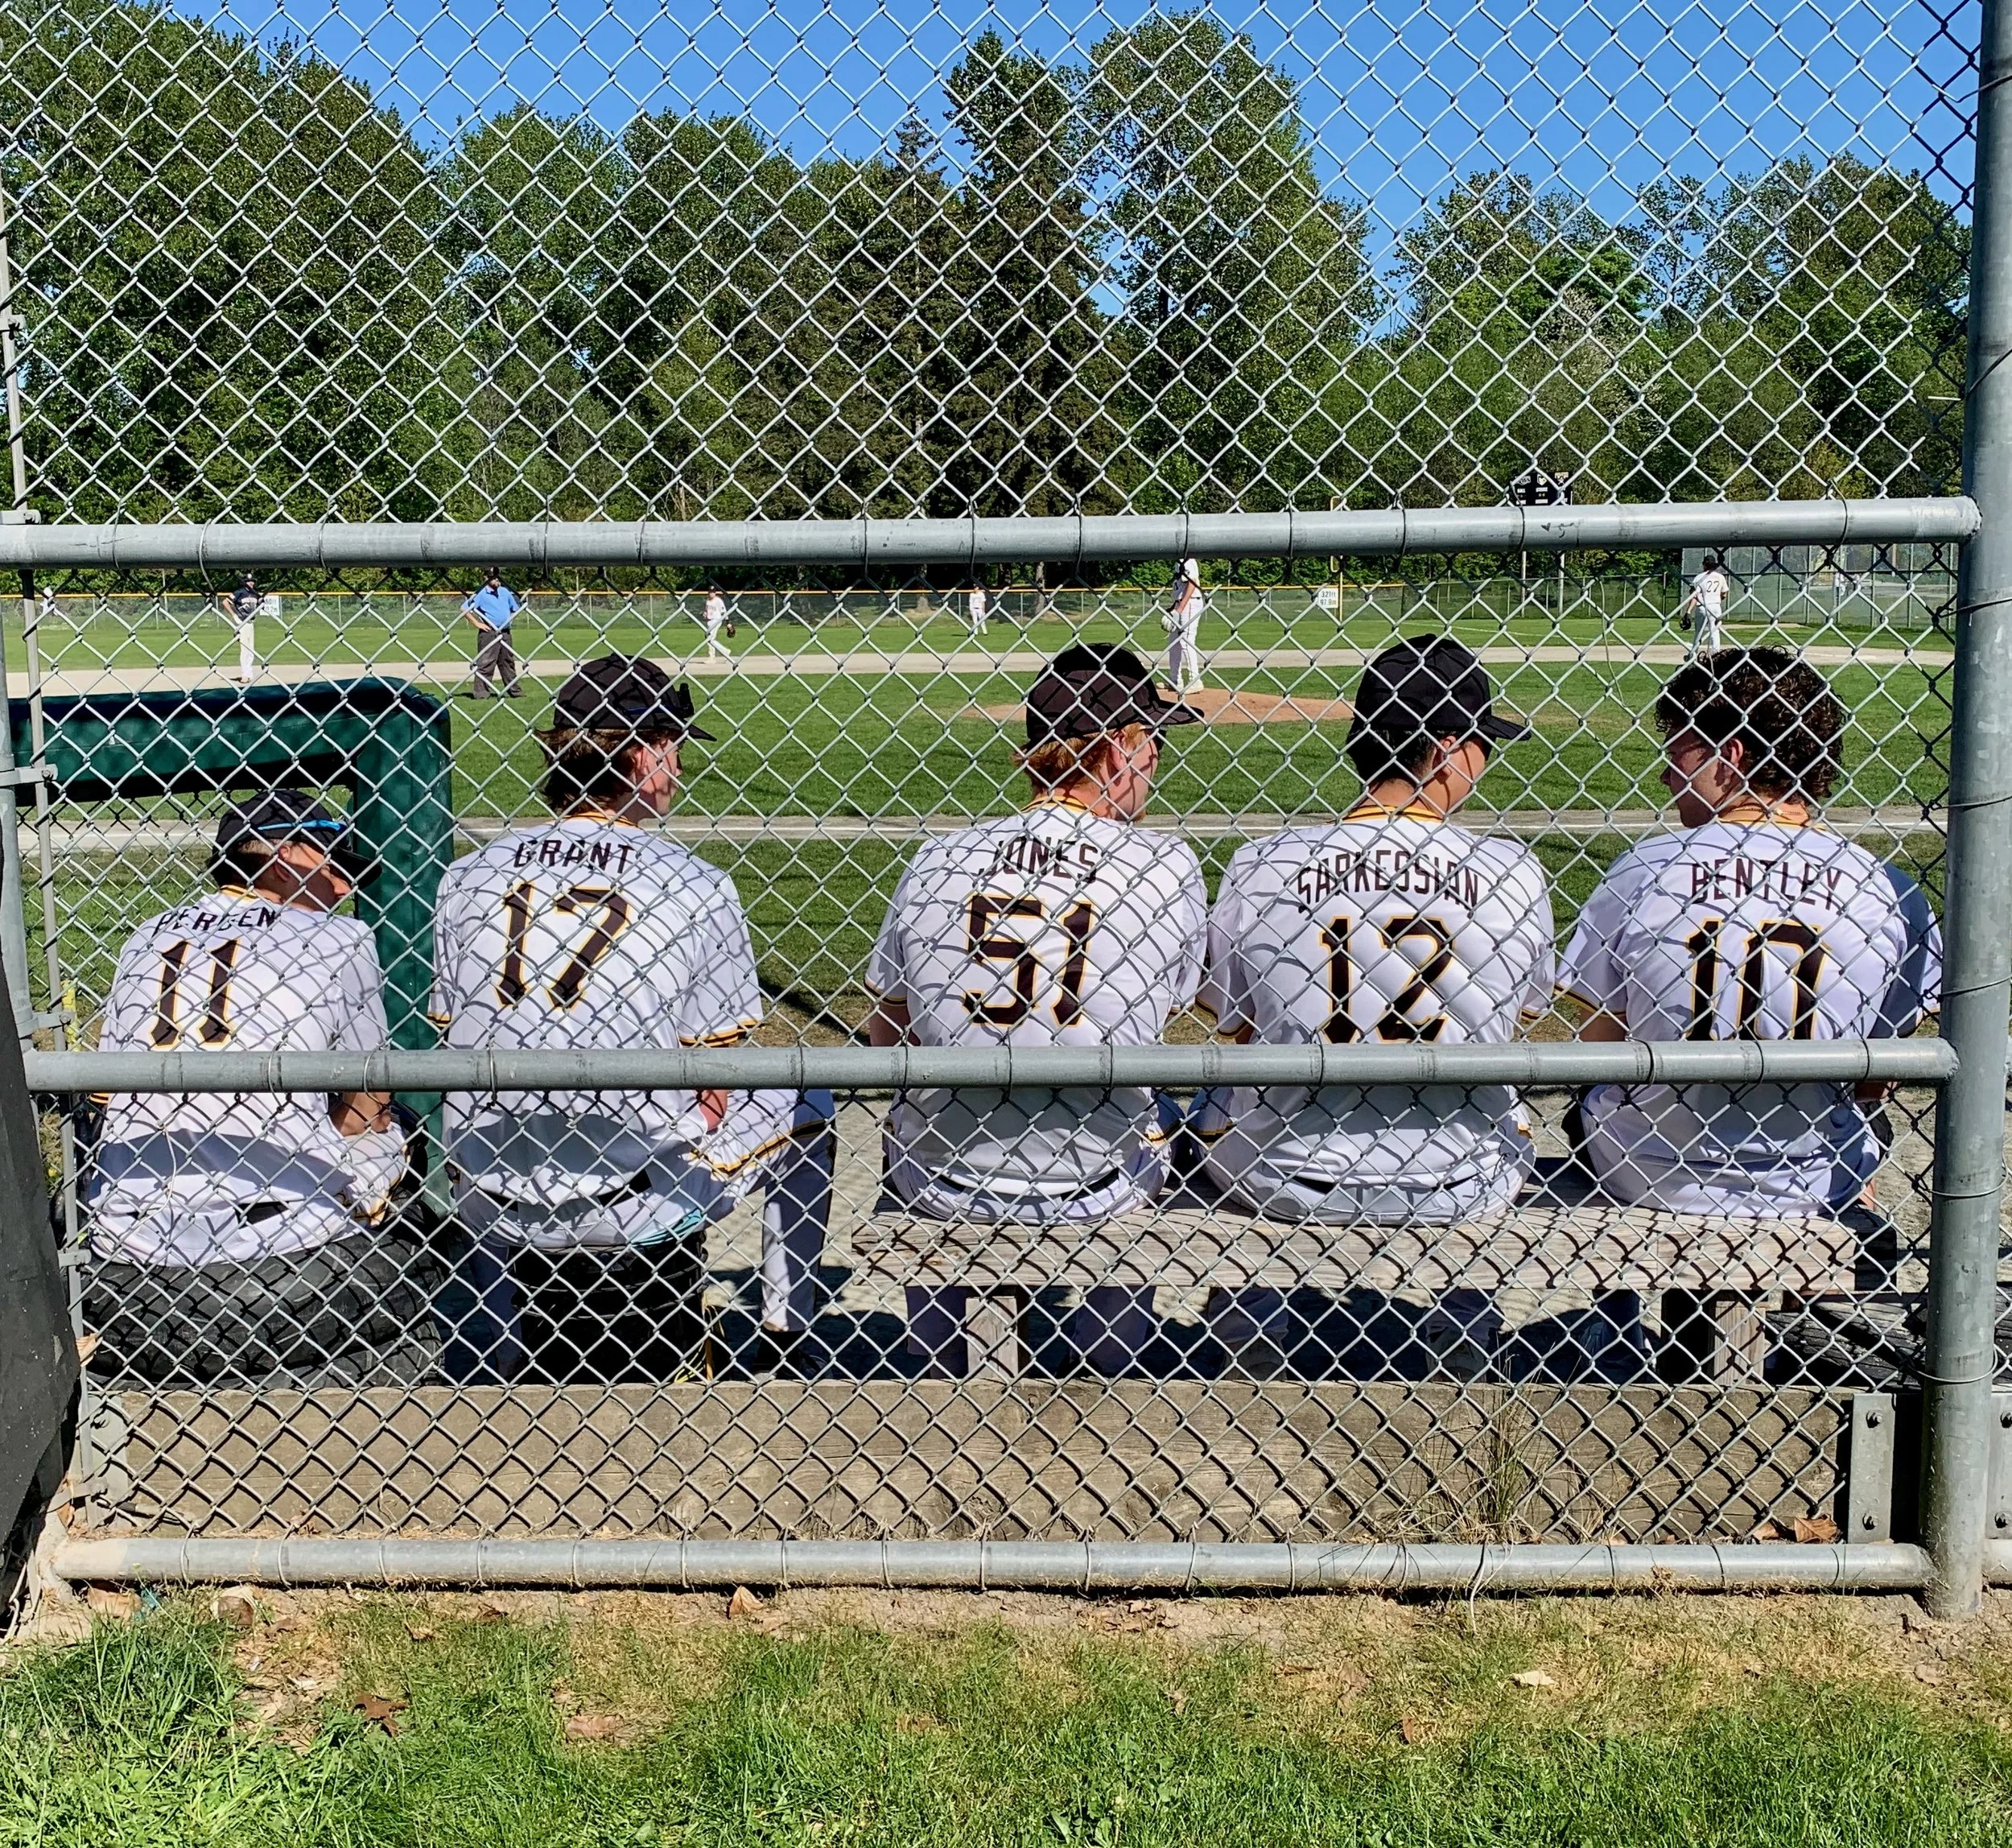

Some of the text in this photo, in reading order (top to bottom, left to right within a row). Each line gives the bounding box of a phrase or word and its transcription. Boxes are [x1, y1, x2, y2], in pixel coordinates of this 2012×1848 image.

[1706, 580, 1720, 593] 27
[513, 839, 635, 874] GRANT
[979, 836, 1099, 884] JONES
[1297, 850, 1478, 913] SARKESSIAN
[1692, 858, 1842, 910] BENTLEY
[495, 882, 632, 1009] 17
[963, 892, 1096, 1029] 51
[1319, 914, 1455, 1043] 12
[1687, 917, 1833, 1041] 10
[149, 938, 242, 1050] 11
